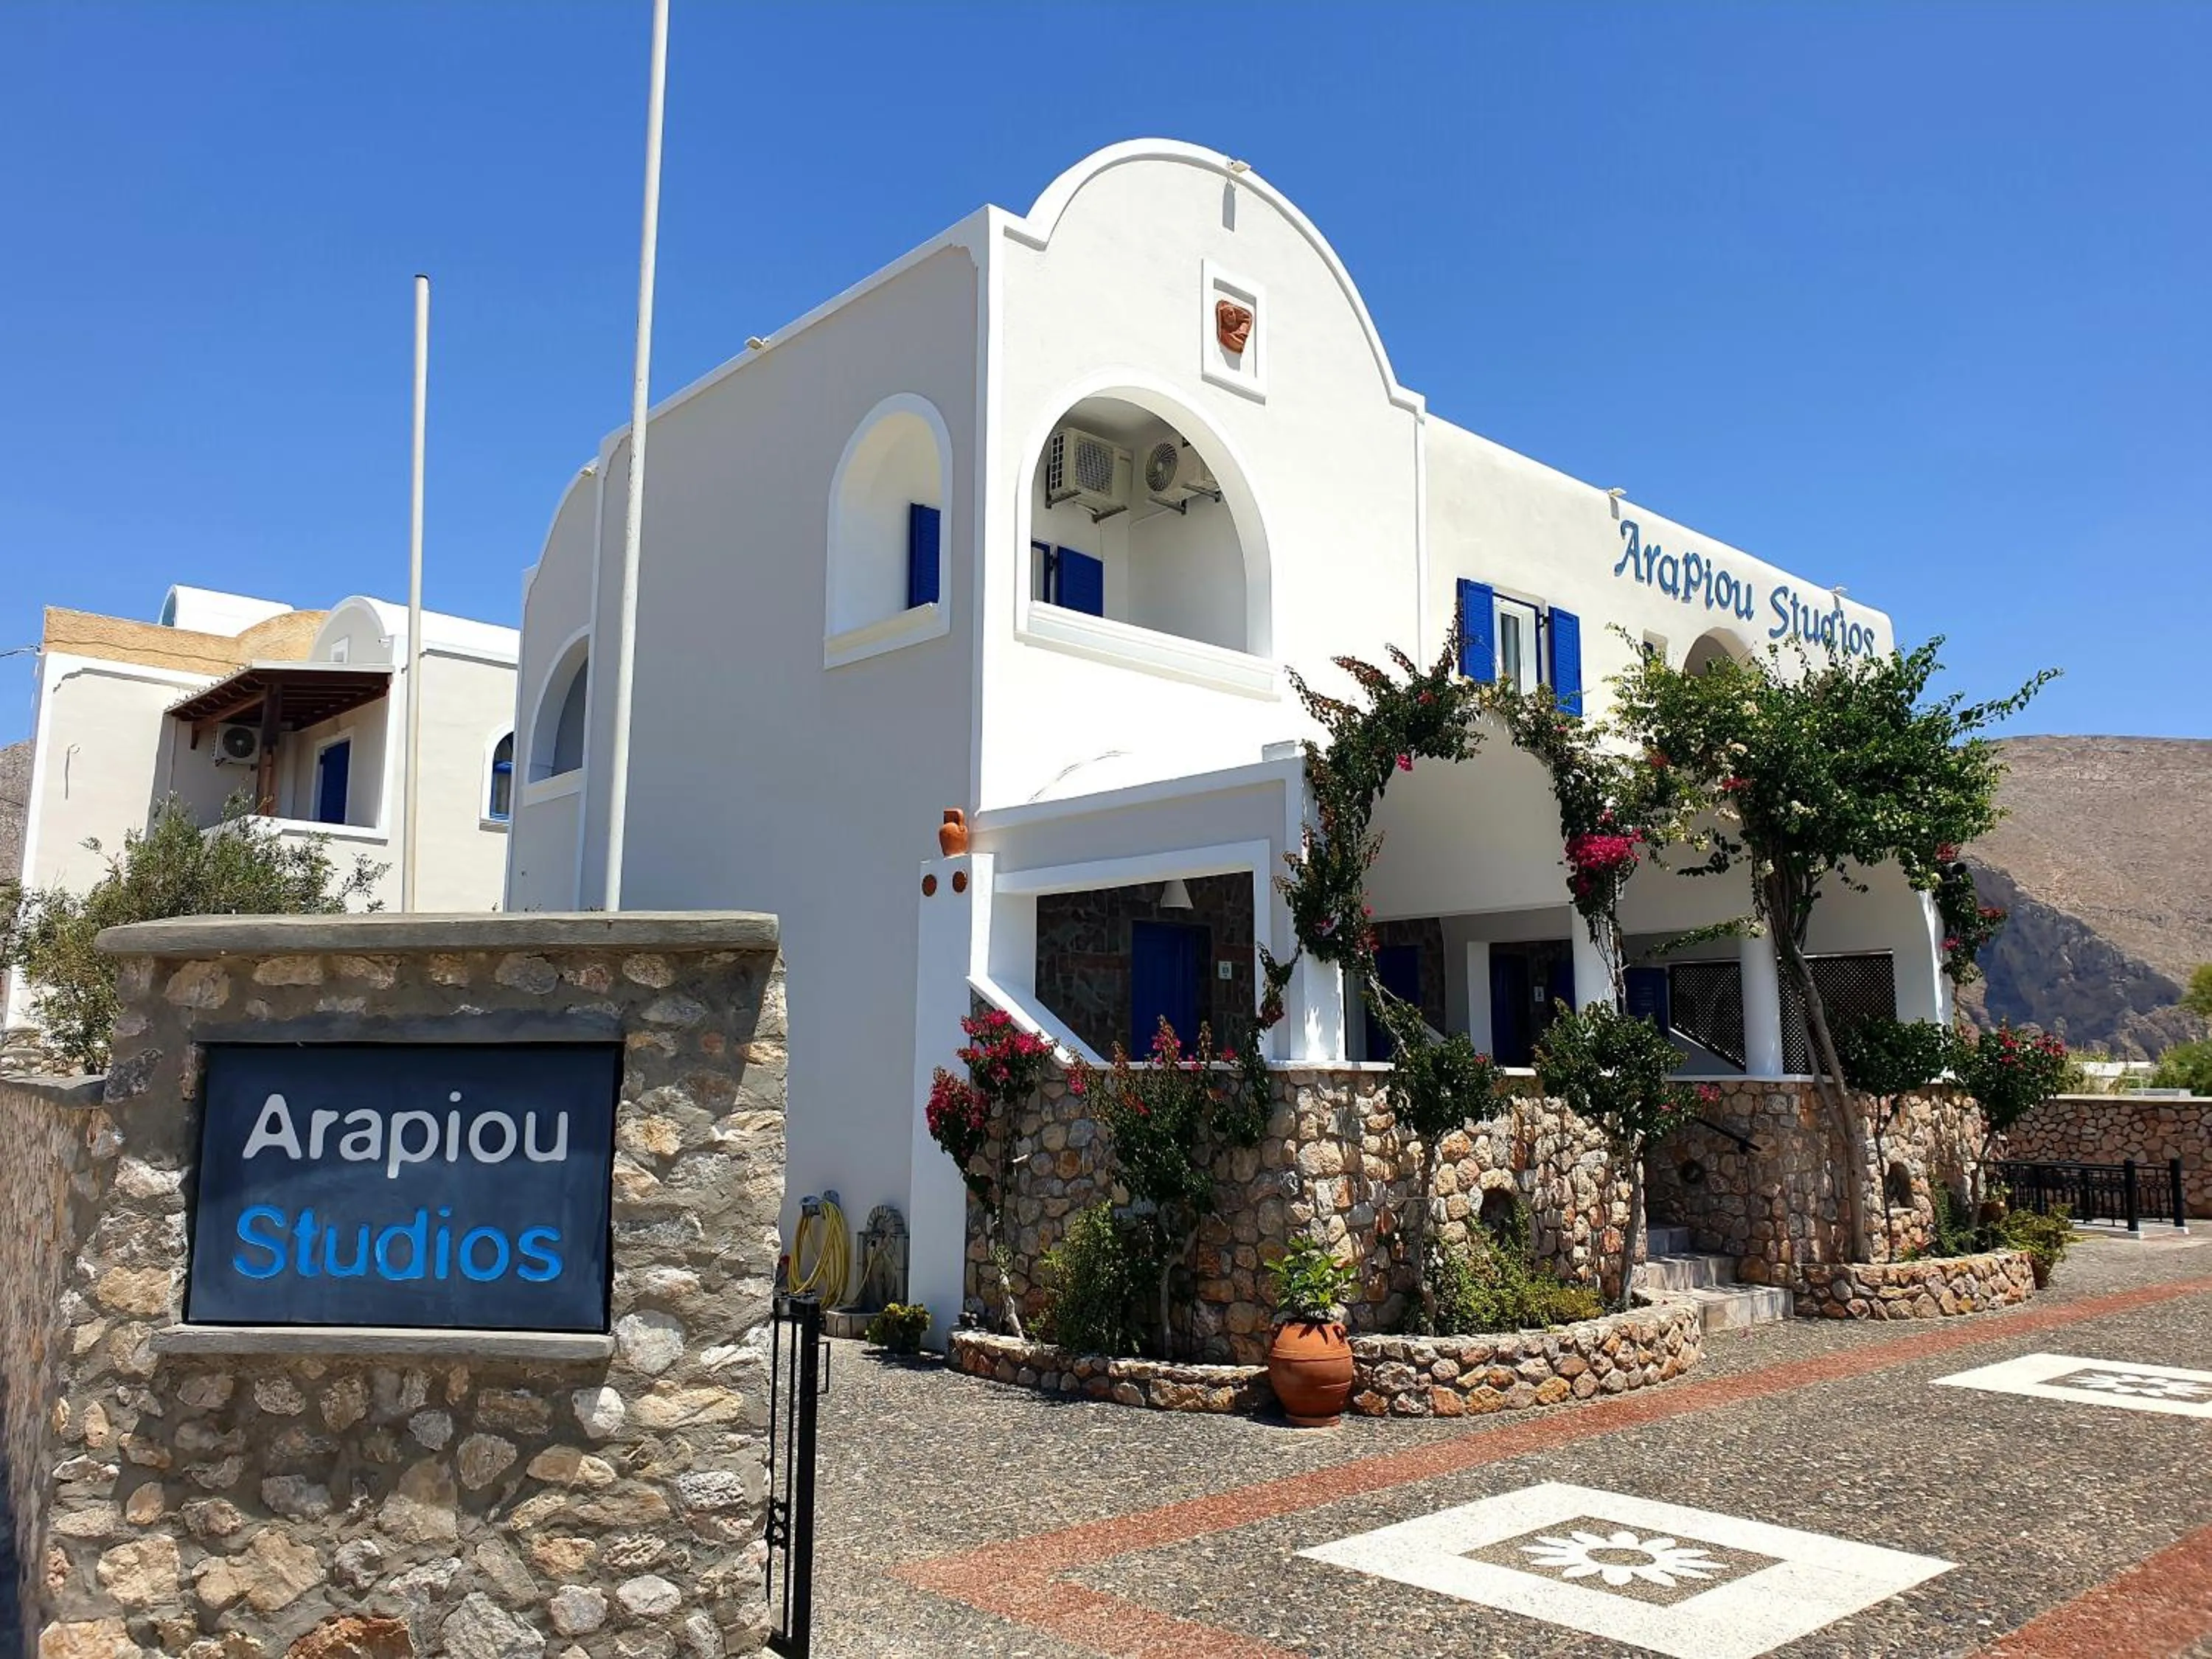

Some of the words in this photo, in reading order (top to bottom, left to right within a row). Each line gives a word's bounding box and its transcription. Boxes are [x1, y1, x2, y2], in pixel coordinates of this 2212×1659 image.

[1613, 519, 1754, 622] Arapiou
[1768, 585, 1875, 658] Studios
[243, 1091, 568, 1179] Arapiou
[233, 1204, 563, 1281] Studios
